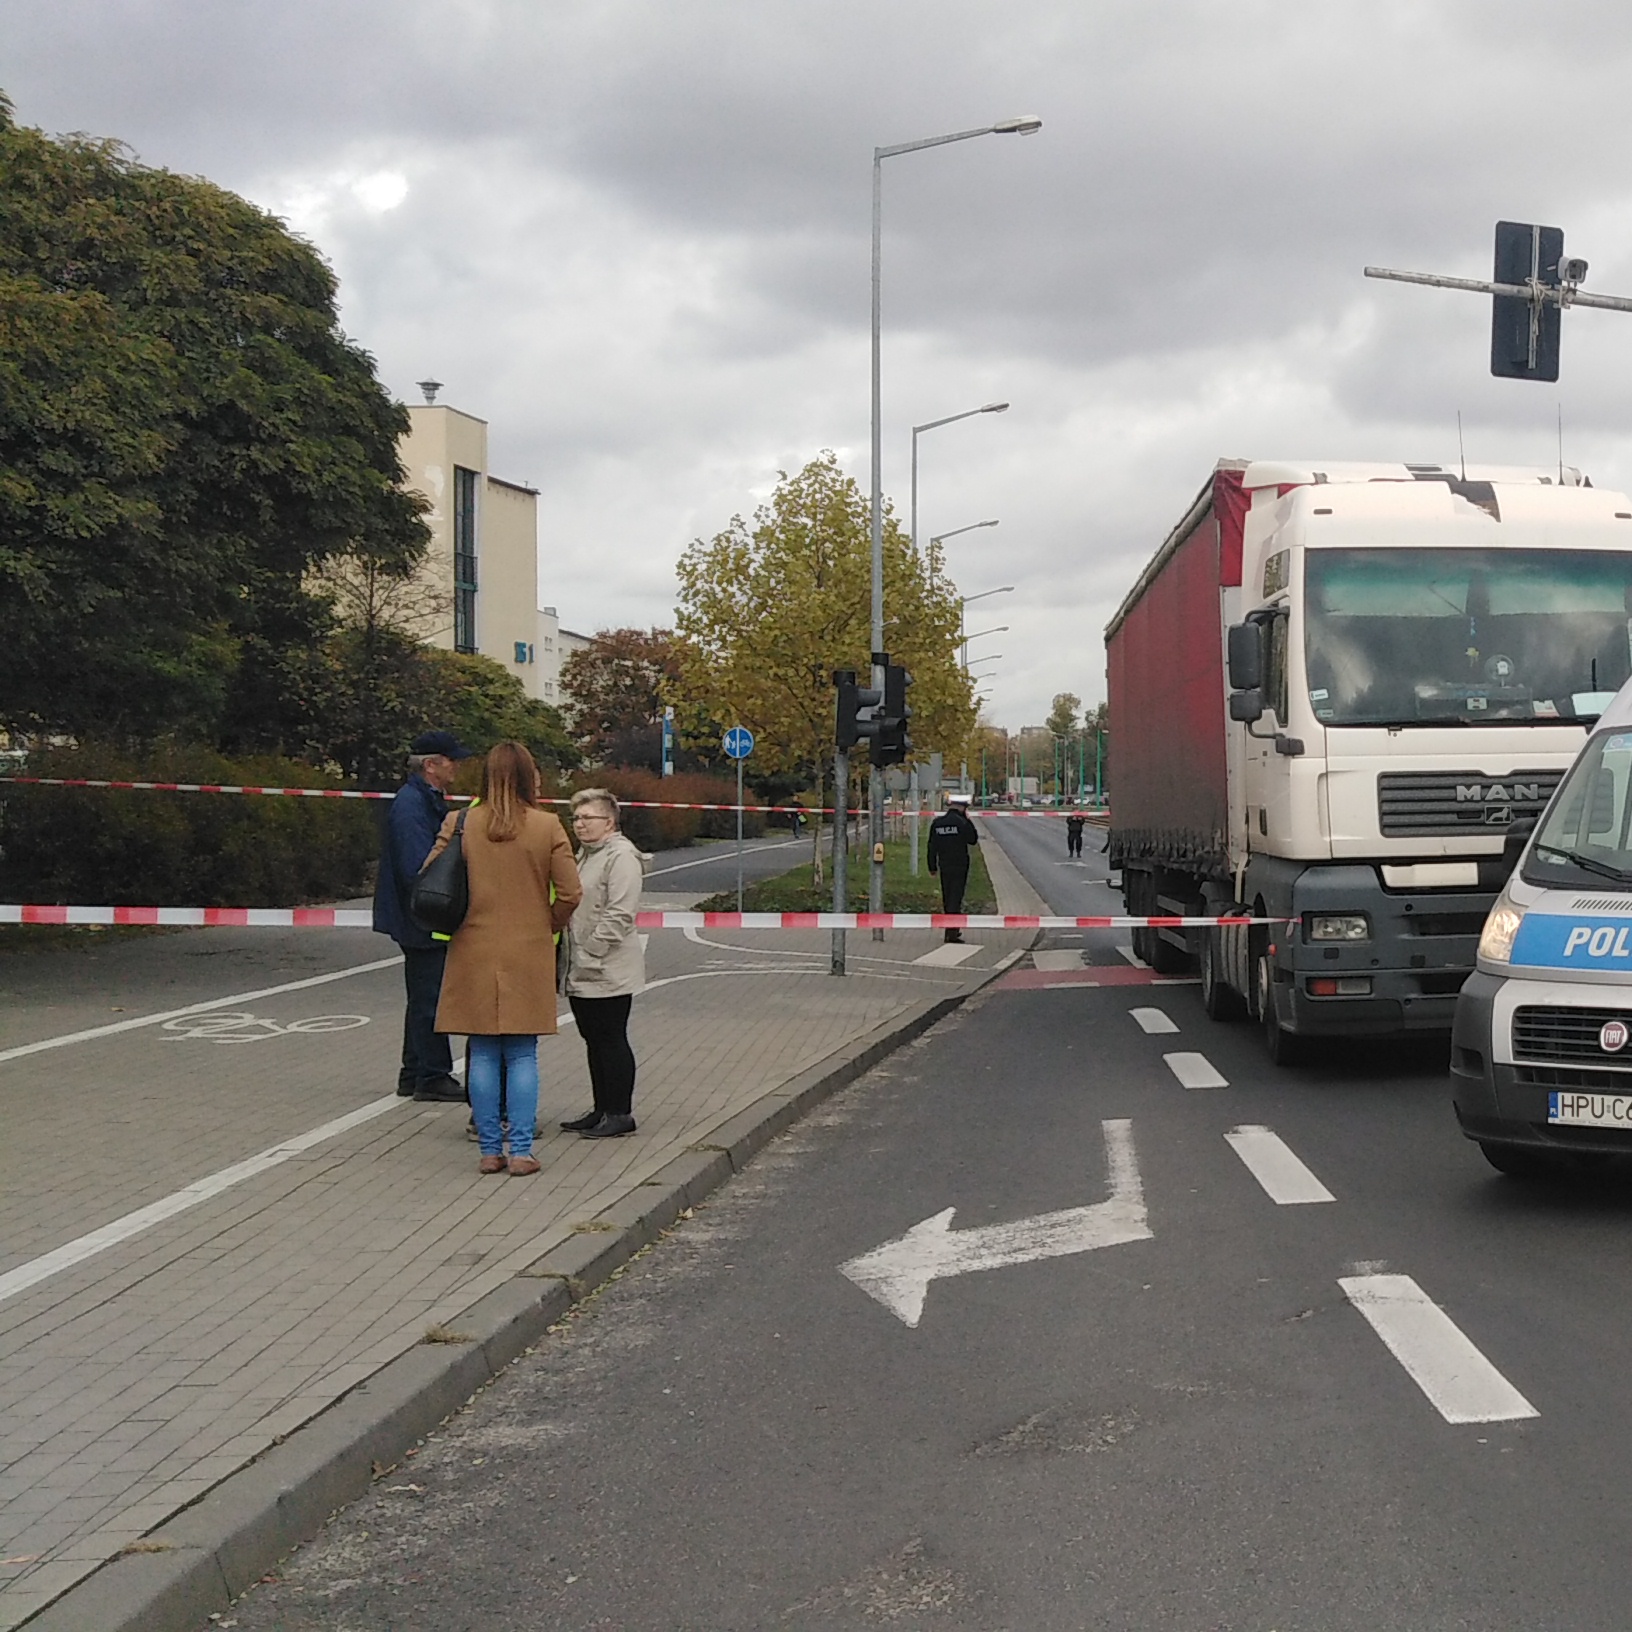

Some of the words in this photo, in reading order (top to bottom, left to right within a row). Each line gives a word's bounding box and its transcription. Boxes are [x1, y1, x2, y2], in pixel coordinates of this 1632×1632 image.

[1456, 784, 1539, 801] MAN
[1605, 1029, 1622, 1044] FIAT
[1561, 1094, 1605, 1119] HPU
